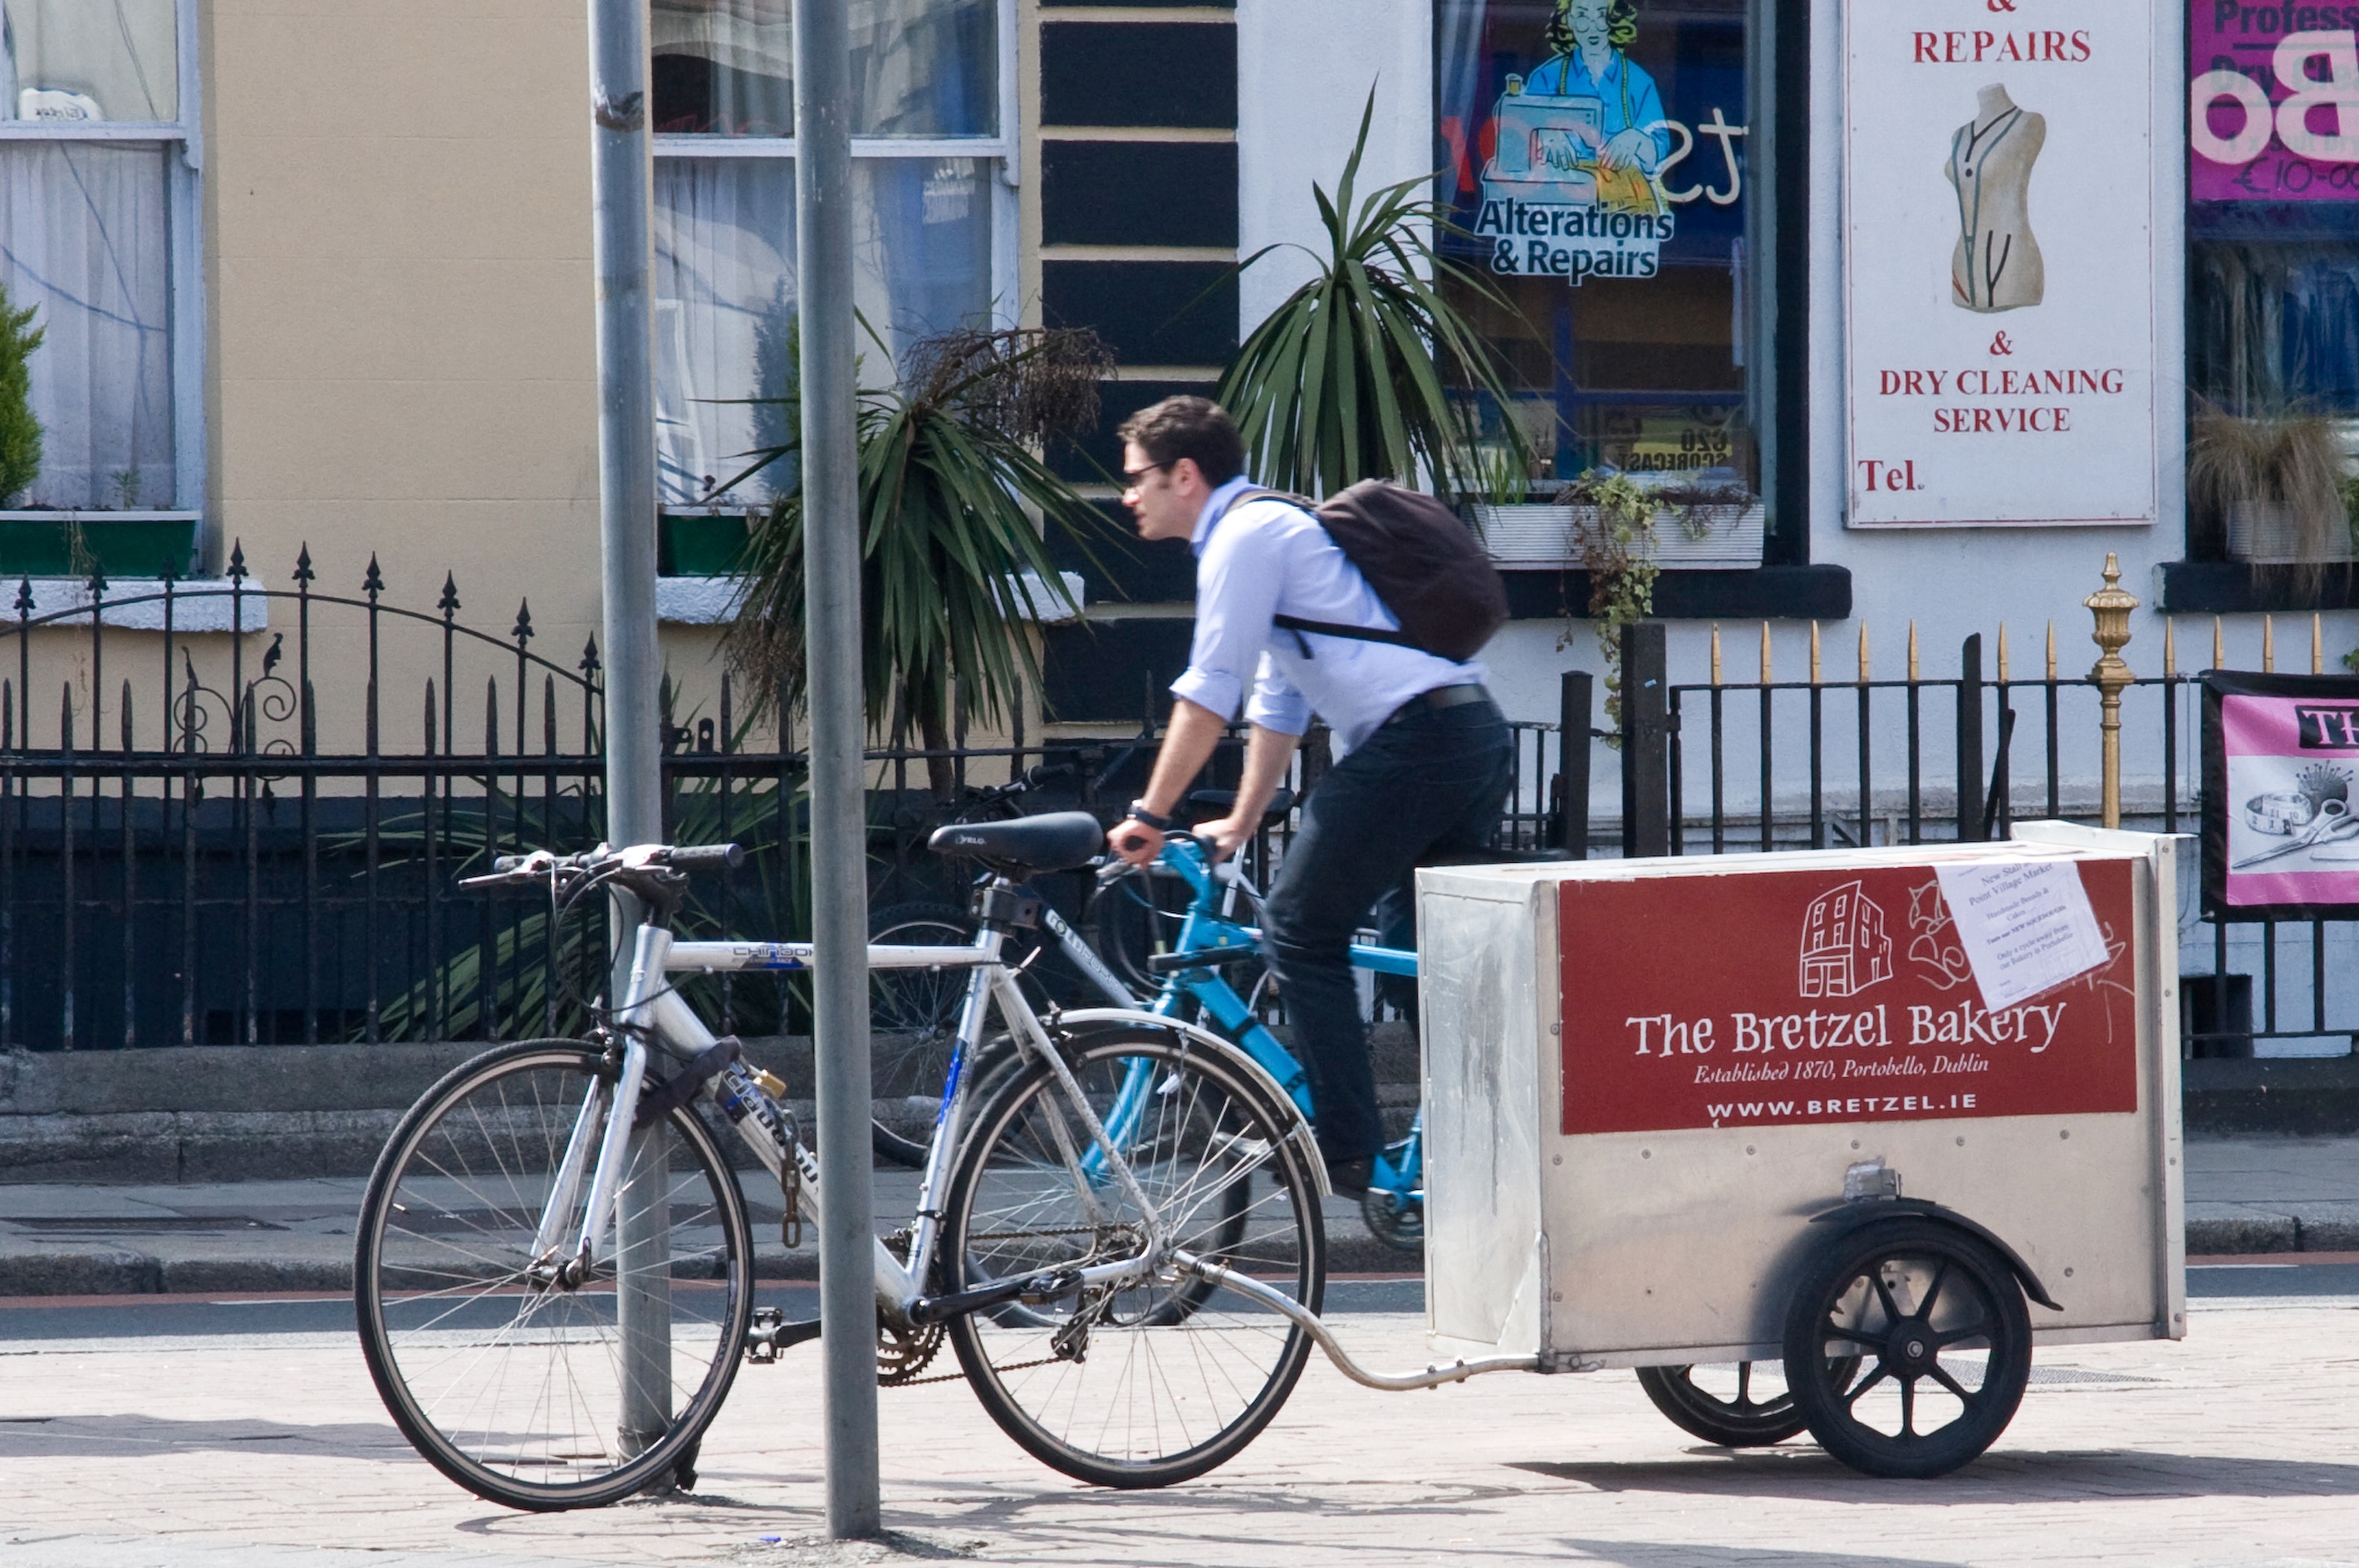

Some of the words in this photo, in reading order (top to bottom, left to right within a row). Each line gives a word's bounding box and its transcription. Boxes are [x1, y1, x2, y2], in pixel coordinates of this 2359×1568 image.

[1911, 30, 2091, 63] REPAIRS
[2210, 54, 2274, 96] Dry
[1478, 199, 1673, 239] Alterations
[1493, 239, 1518, 272] &
[1528, 241, 1656, 284] Repairs
[1989, 331, 2013, 355] &
[1879, 370, 1948, 395] DRY
[1957, 369, 2124, 394] CLEANING
[1934, 408, 2071, 433] SERVICE
[1858, 460, 1925, 492] Tel.
[1968, 889, 1992, 907] Point
[1992, 875, 2023, 898] Village
[2023, 861, 2053, 881] Market
[1626, 1013, 1715, 1057] The
[1731, 1004, 1892, 1054] Bretzel
[1907, 999, 2067, 1053] Bakery
[1694, 1061, 1789, 1084] Established
[1793, 1060, 1837, 1080] 1870,
[1842, 1056, 1927, 1077] Portobello,
[1932, 1053, 1989, 1075] Dublin
[1707, 1093, 1977, 1118] WWW.BRETZEL.IE
